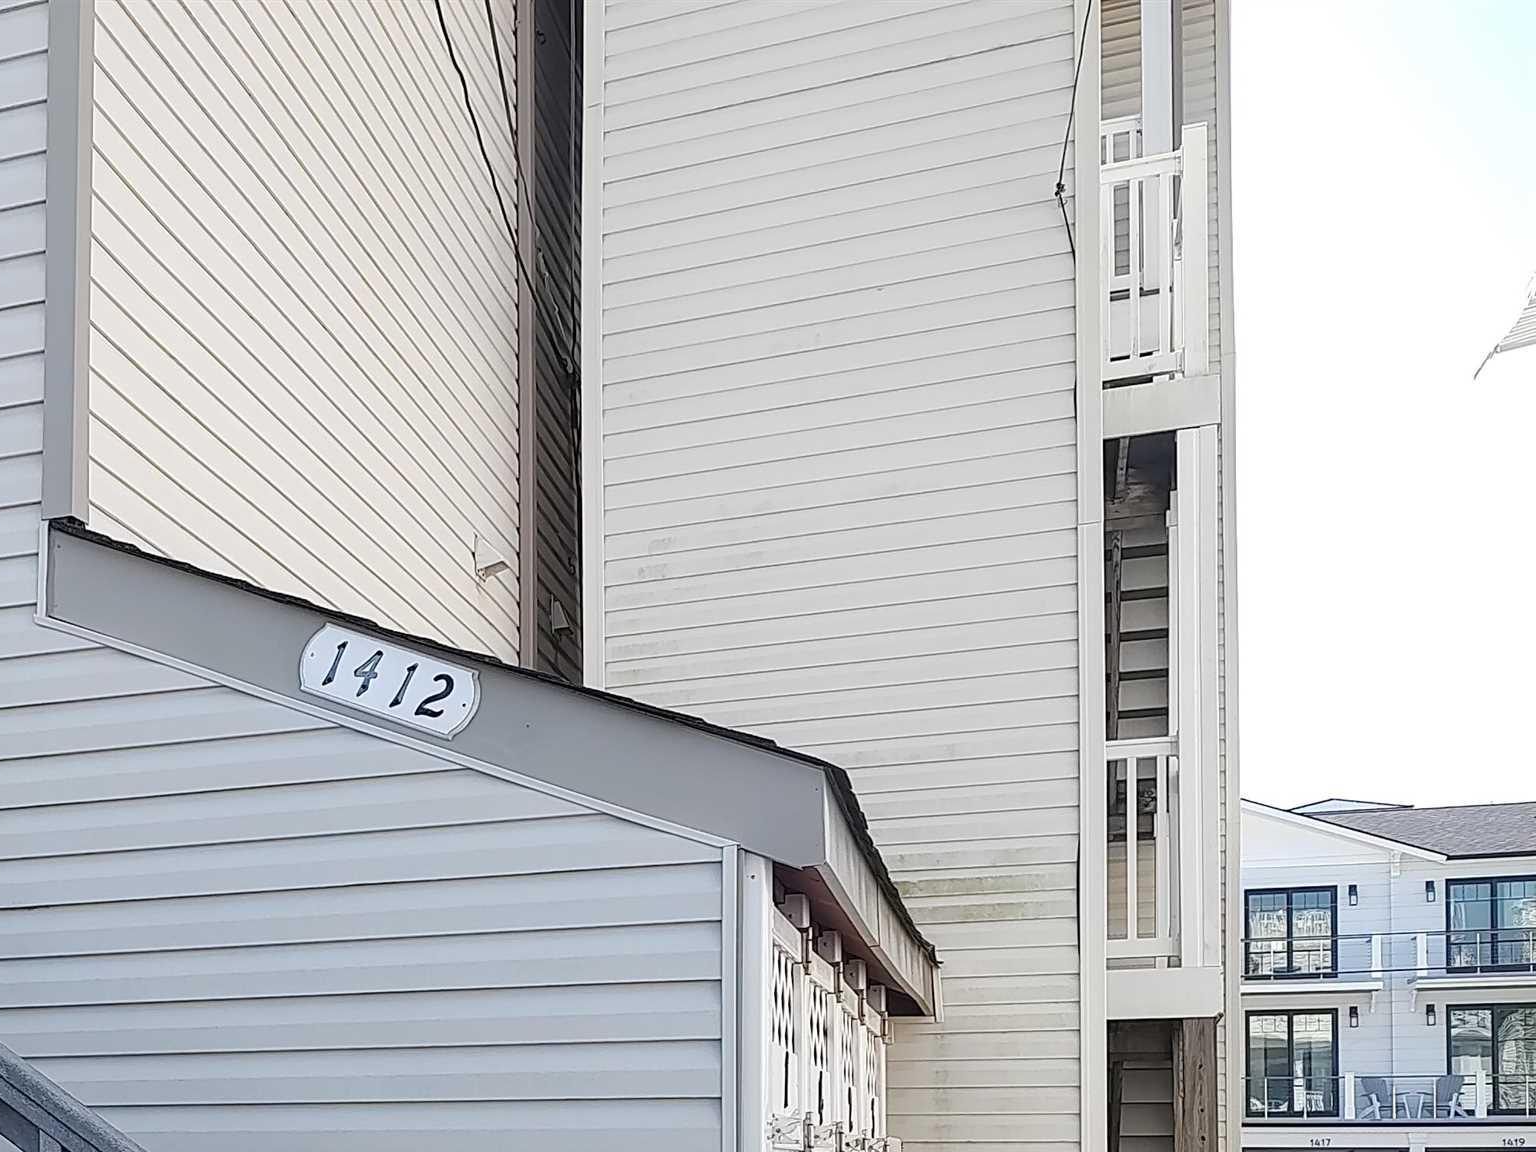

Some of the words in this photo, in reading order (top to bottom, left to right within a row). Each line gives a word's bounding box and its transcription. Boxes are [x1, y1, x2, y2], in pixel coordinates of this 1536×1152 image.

[322, 641, 454, 717] 1412
[1310, 1138, 1331, 1146] 1417
[1502, 1137, 1526, 1146] 1419
